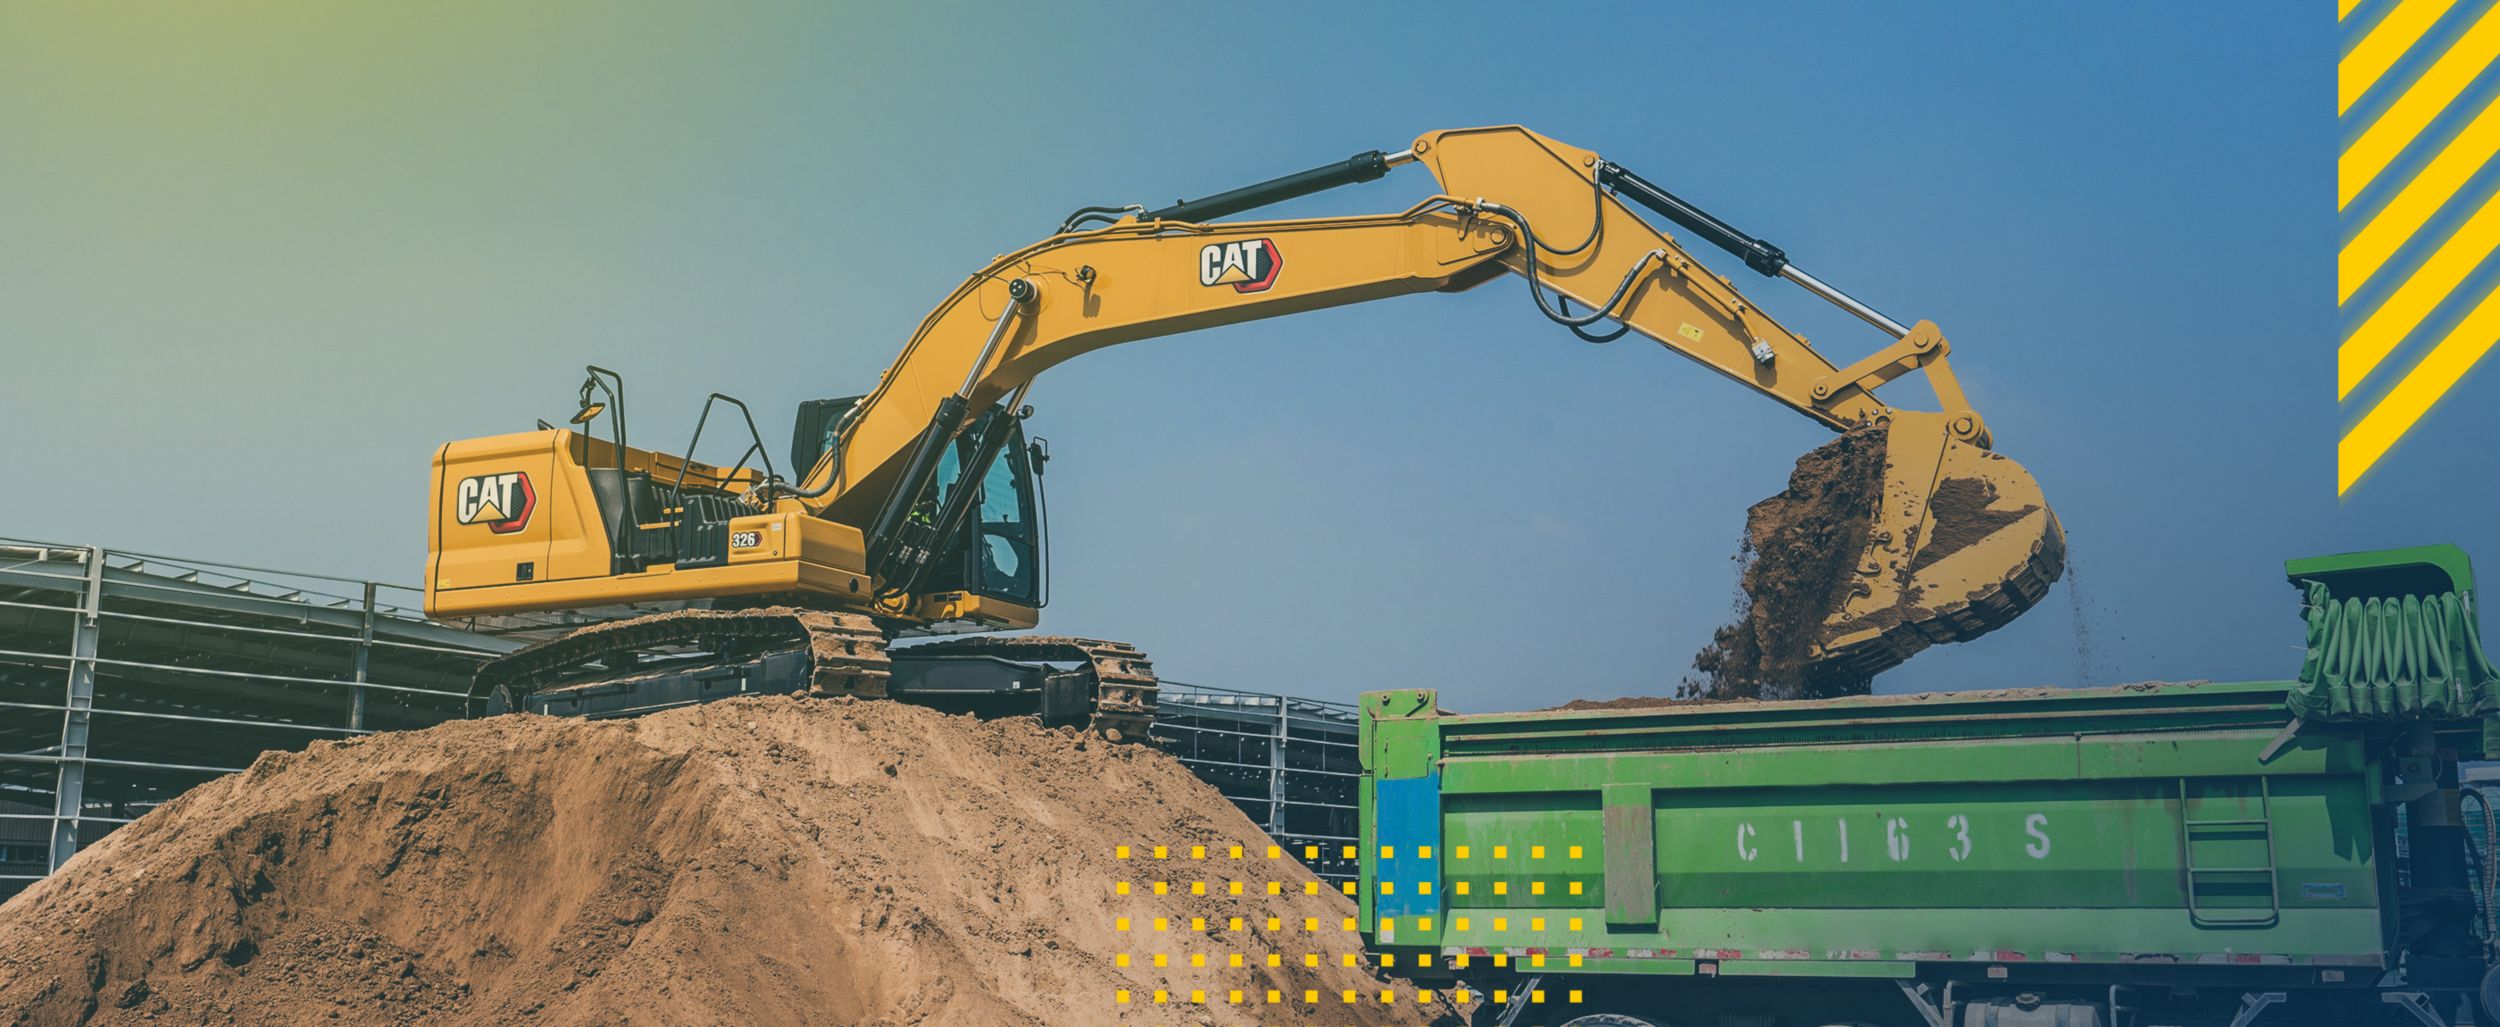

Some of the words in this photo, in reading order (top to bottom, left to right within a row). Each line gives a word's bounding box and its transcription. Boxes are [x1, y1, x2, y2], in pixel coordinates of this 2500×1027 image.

[1201, 240, 1262, 285] CAT
[459, 474, 518, 523] CAT
[733, 533, 755, 547] 326
